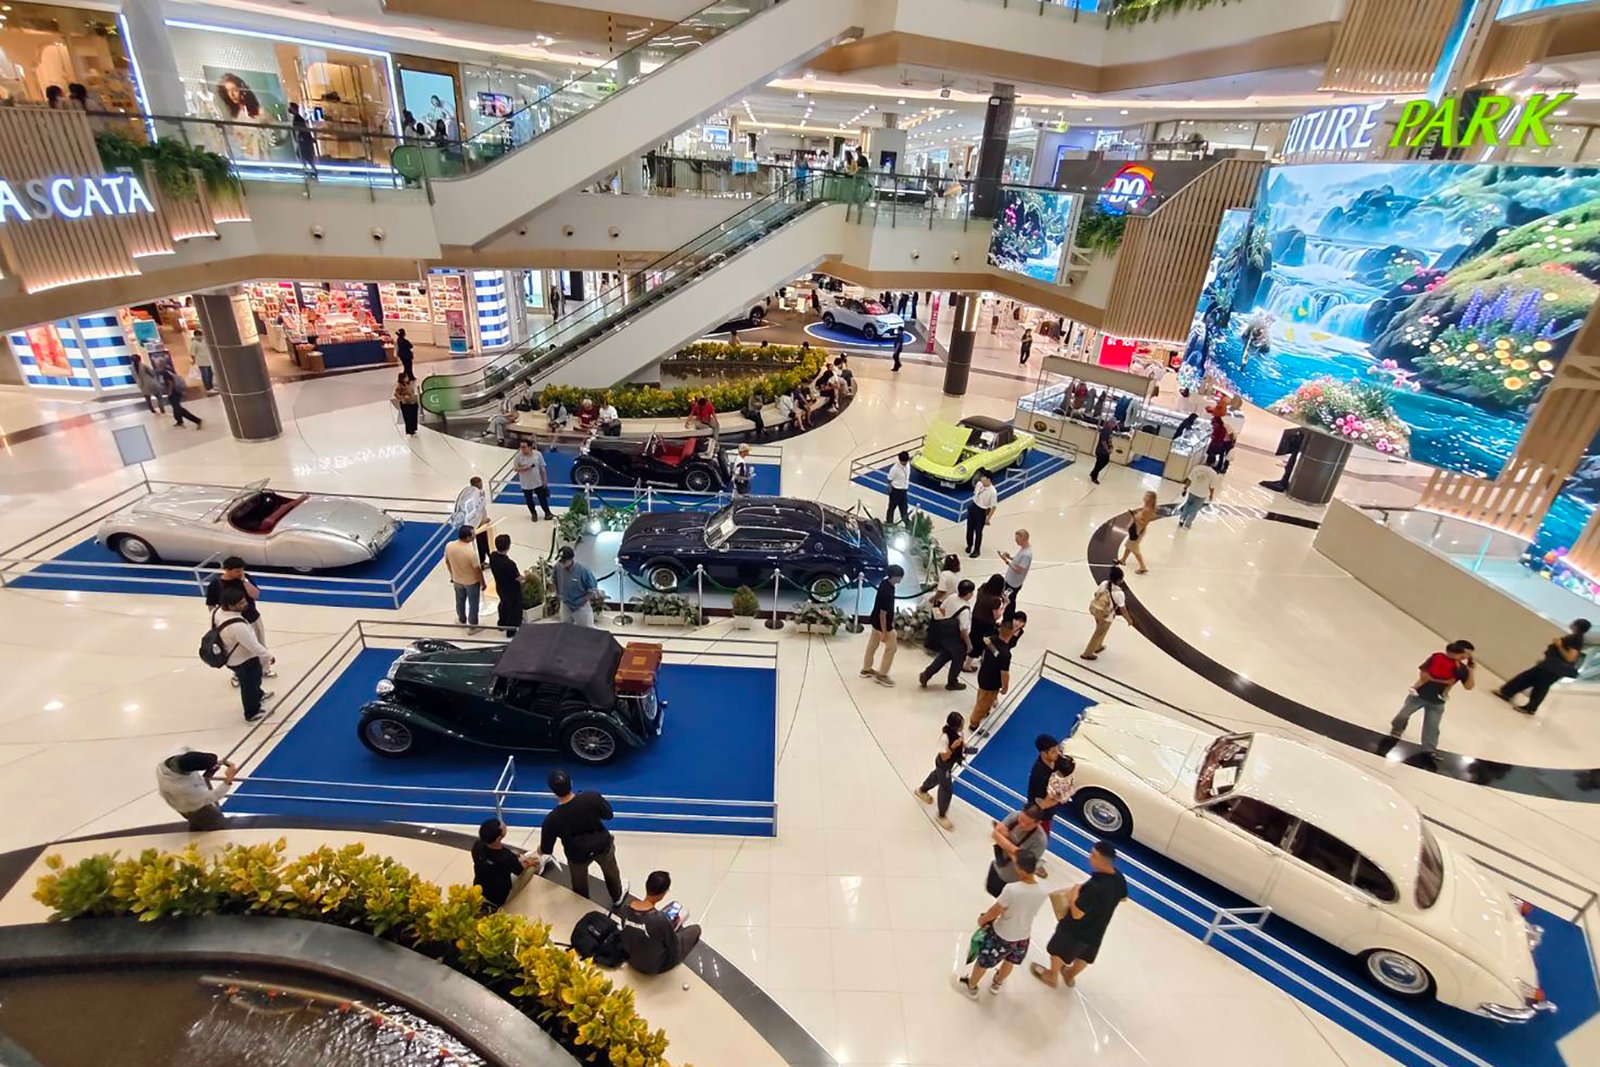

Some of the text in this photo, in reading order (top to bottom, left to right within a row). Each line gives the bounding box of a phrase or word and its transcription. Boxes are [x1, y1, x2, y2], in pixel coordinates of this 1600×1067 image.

[1282, 93, 1577, 155] FUTURE PARK
[1109, 178, 1145, 209] DQ
[430, 394, 440, 403] G
